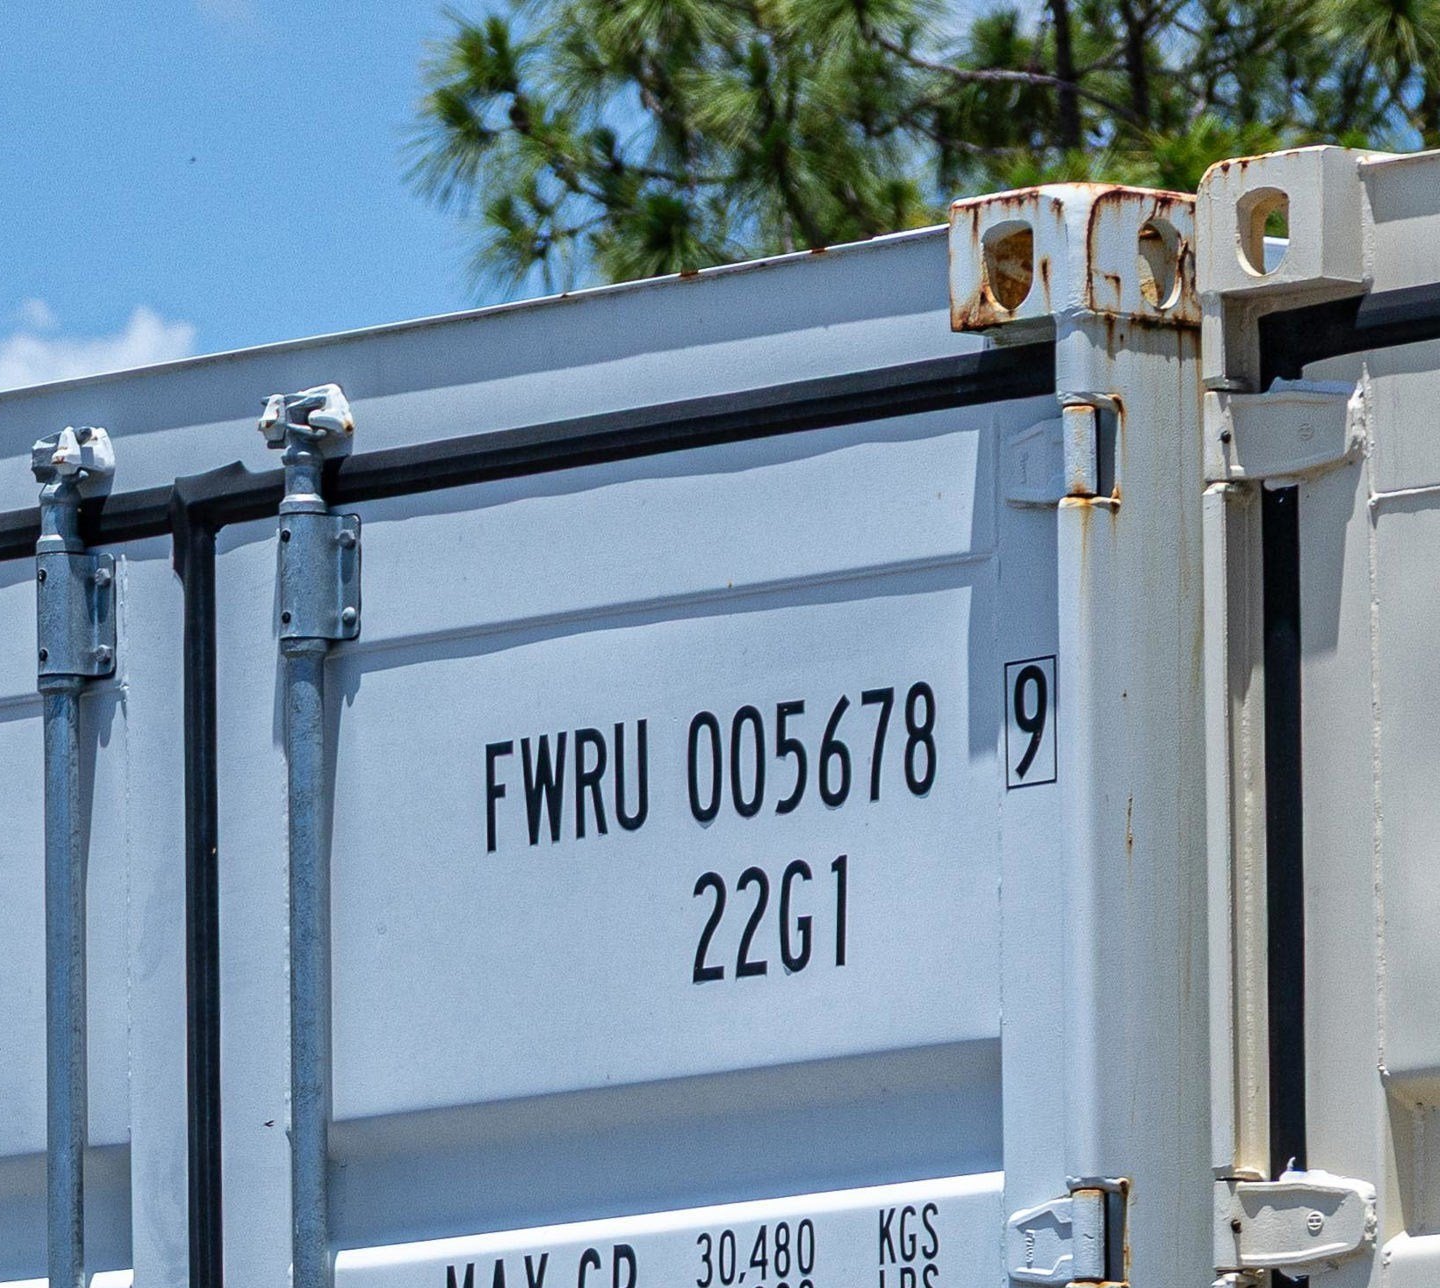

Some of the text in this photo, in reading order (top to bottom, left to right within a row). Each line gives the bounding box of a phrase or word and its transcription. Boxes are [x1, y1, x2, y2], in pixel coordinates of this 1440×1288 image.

[484, 664, 1050, 853] FWRU 005678 9
[691, 854, 848, 983] 22G1
[696, 1218, 815, 1288] 30,480
[880, 1203, 939, 1264] KGS
